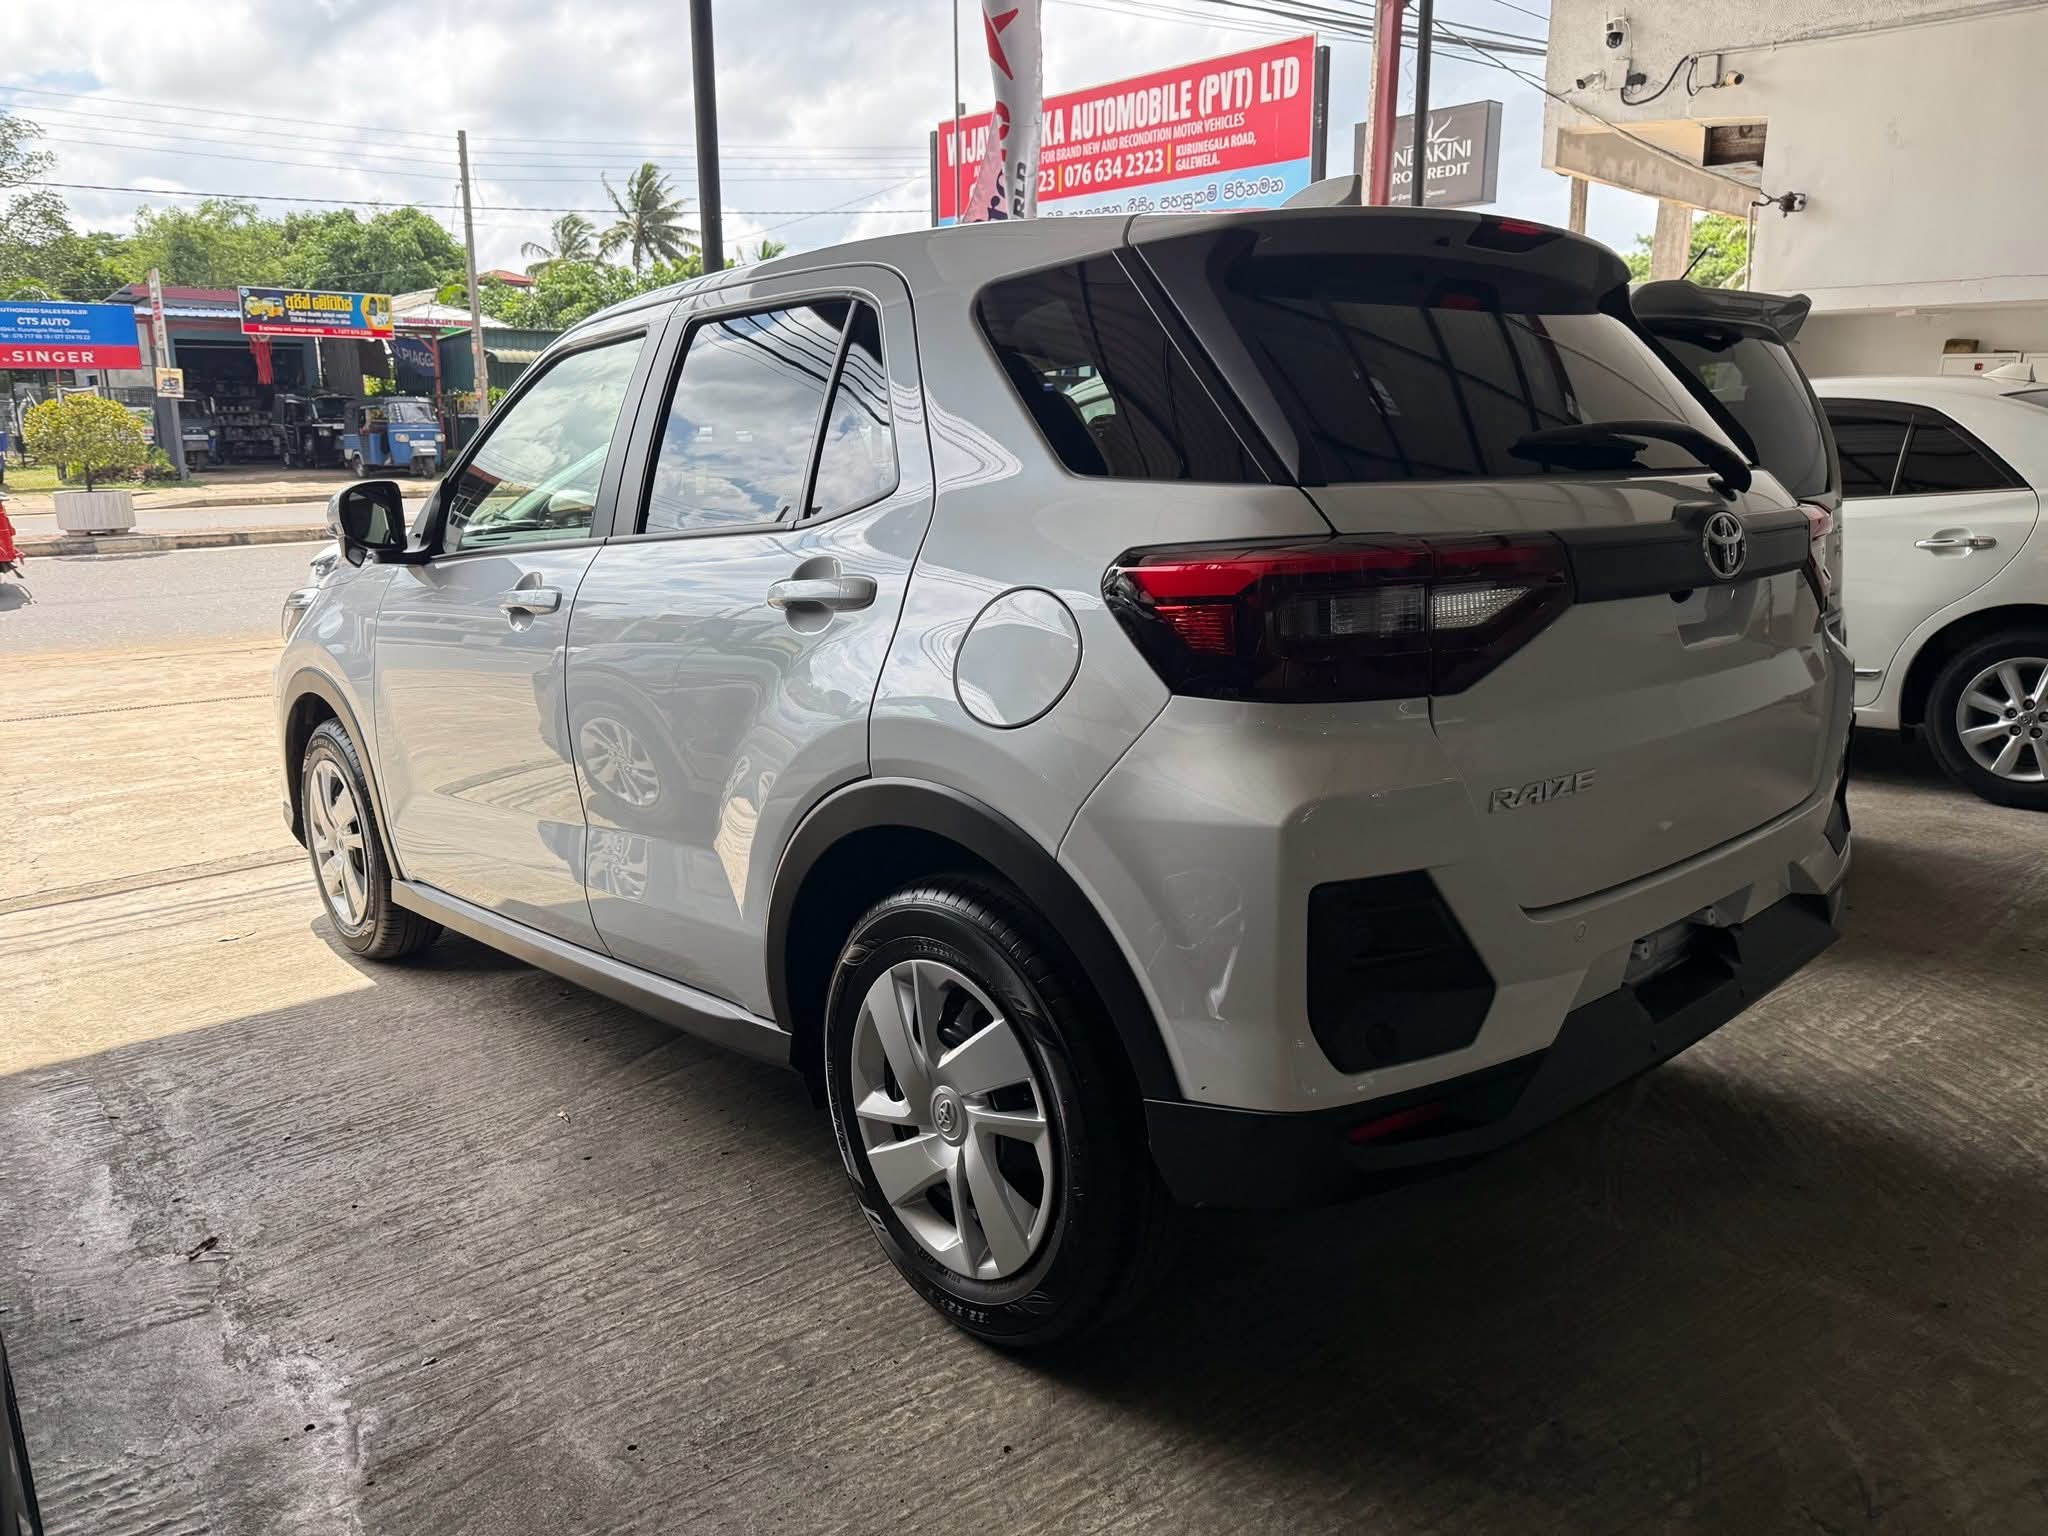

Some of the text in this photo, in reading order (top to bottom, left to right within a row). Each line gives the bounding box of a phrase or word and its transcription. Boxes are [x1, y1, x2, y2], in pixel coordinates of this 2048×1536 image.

[1070, 79, 1192, 142] AUTOMOBILE
[1198, 67, 1253, 117] (PVT)
[1260, 56, 1300, 104] LTD
[1041, 111, 1245, 164] FOR BRAND NEW AND RECONDITION MOTOR VEHICLES
[1175, 130, 1256, 158] KURUNEGALA ROAD,
[1064, 161, 1091, 188] 076
[1094, 156, 1122, 183] 634
[1125, 149, 1164, 179] 2323
[1175, 152, 1220, 172] GALEWELA.
[1427, 161, 1470, 180] REDIT
[17, 316, 71, 327] CTS AUTO
[11, 350, 95, 363] SINGER
[1488, 768, 1597, 814] RAIZE
